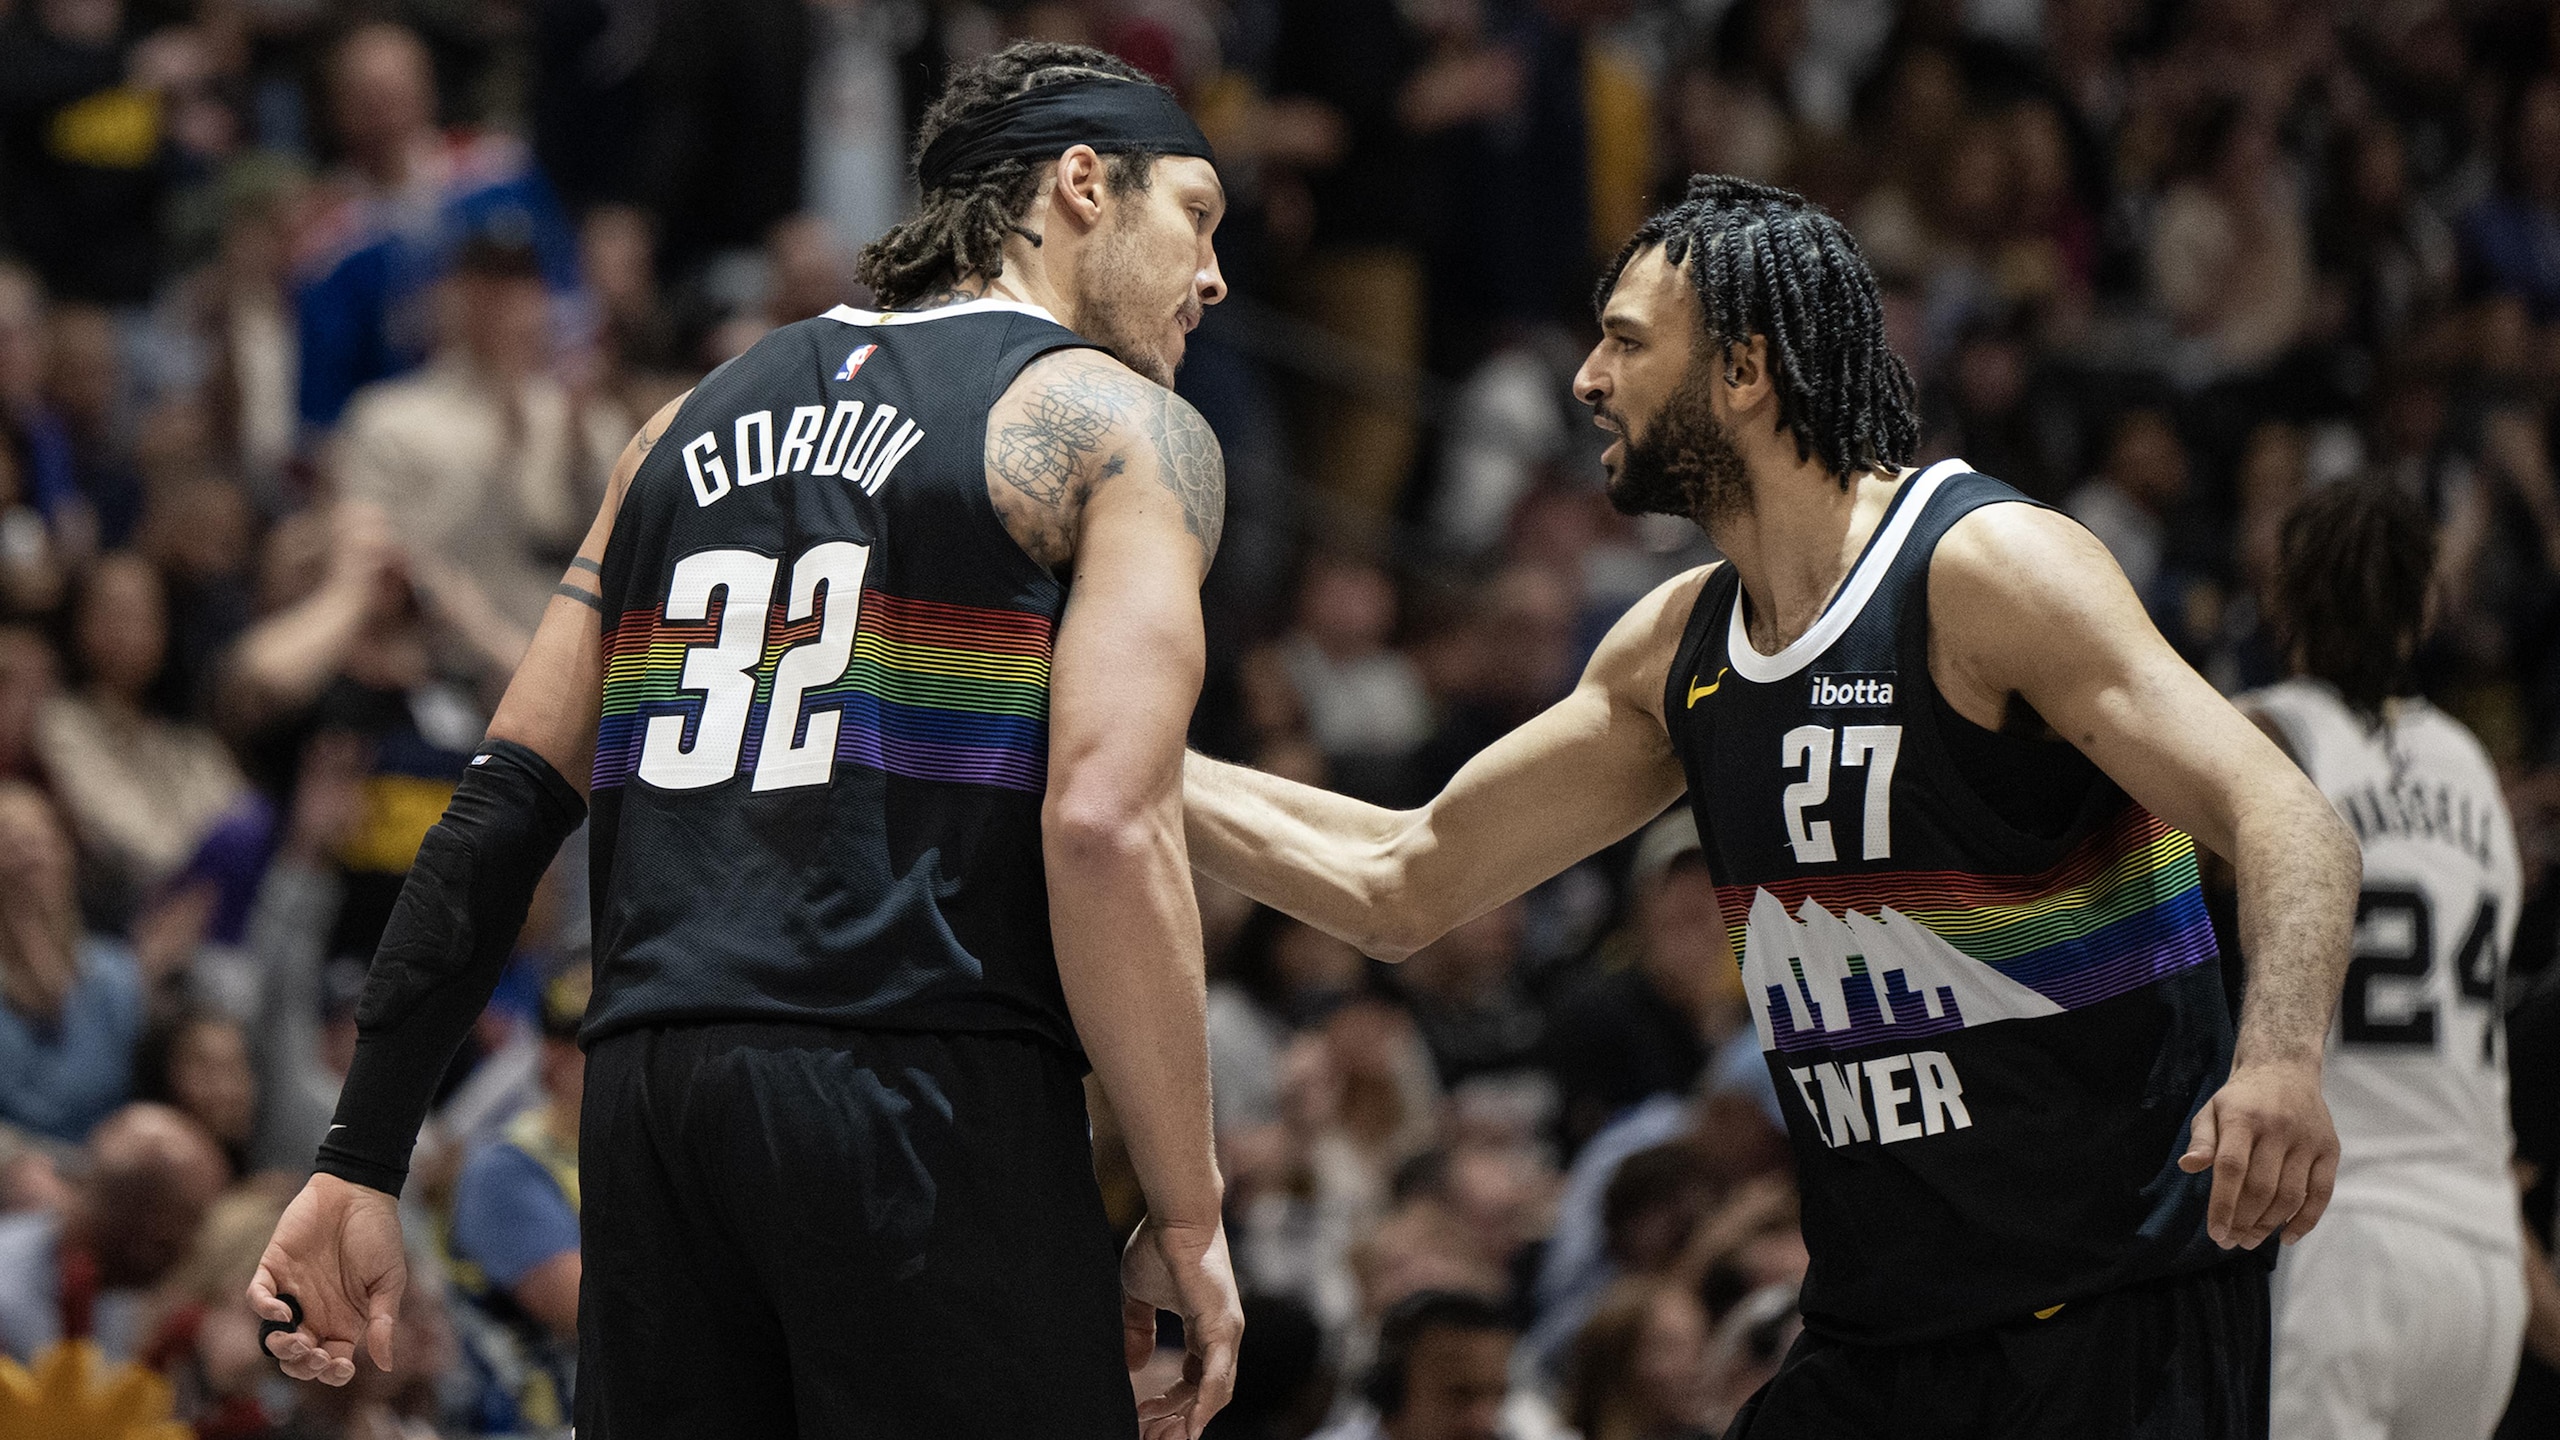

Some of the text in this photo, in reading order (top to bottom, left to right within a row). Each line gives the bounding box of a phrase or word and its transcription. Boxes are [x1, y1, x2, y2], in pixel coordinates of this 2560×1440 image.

[681, 400, 925, 507] GORDON
[637, 540, 871, 792] 32
[1810, 676, 1895, 705] ibotta
[1782, 724, 1903, 864] 27
[2339, 888, 2500, 1068] 24
